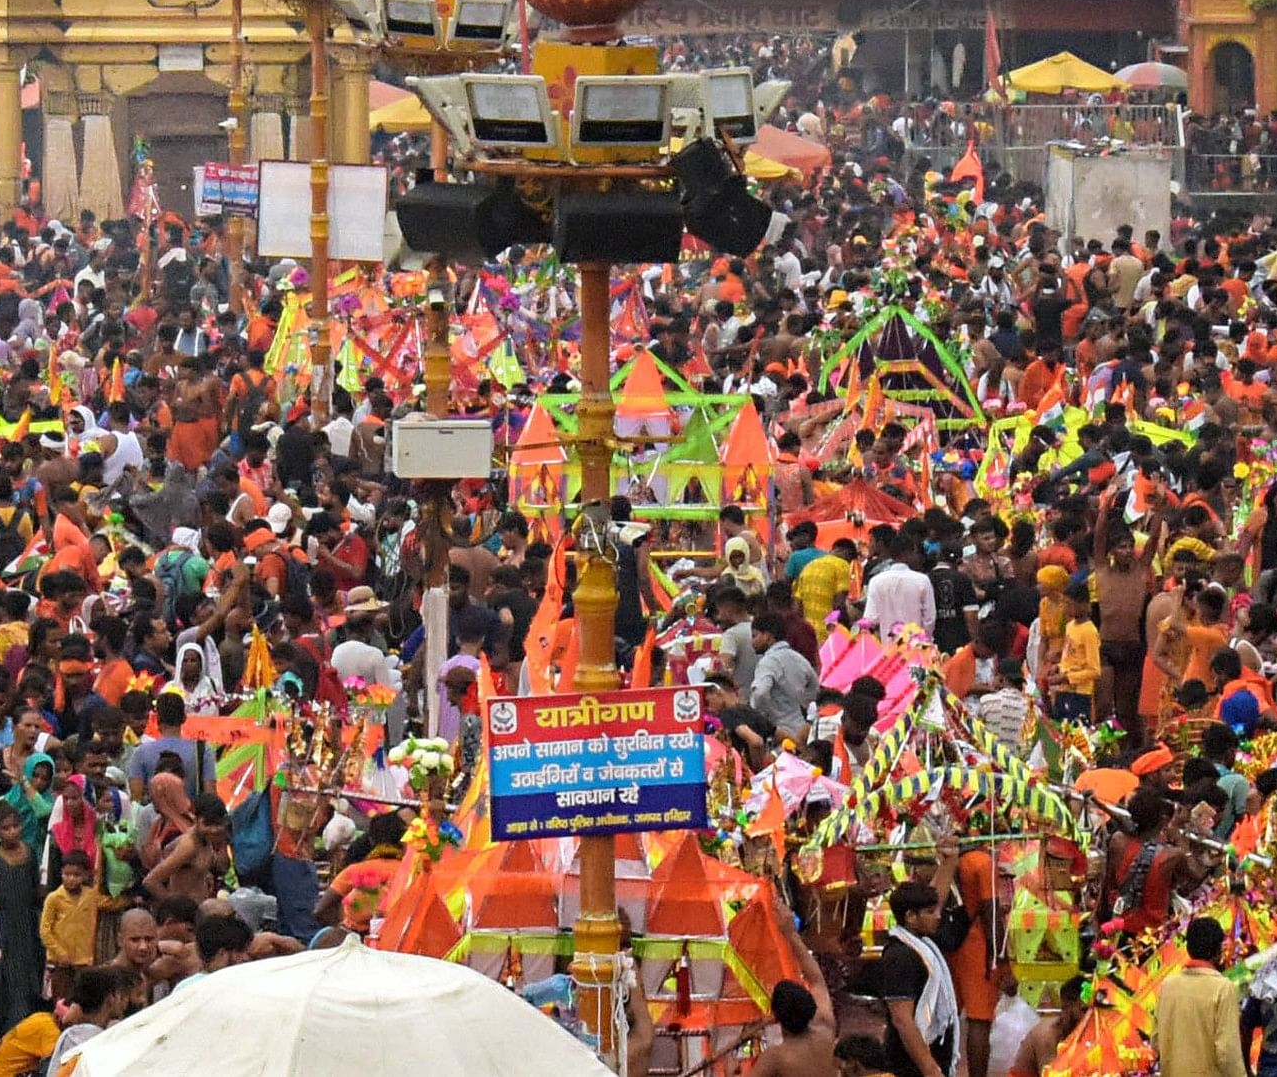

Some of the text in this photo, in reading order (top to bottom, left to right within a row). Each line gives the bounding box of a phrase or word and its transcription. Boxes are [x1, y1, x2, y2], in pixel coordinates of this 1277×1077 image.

[535, 696, 656, 729] यात्रीगण
[493, 738, 531, 762] अपने
[535, 739, 583, 759] सामान
[587, 733, 609, 754] को
[613, 729, 665, 760] सुरक्षित
[582, 767, 594, 782] व
[670, 757, 684, 778] से
[556, 788, 616, 809] सावधान
